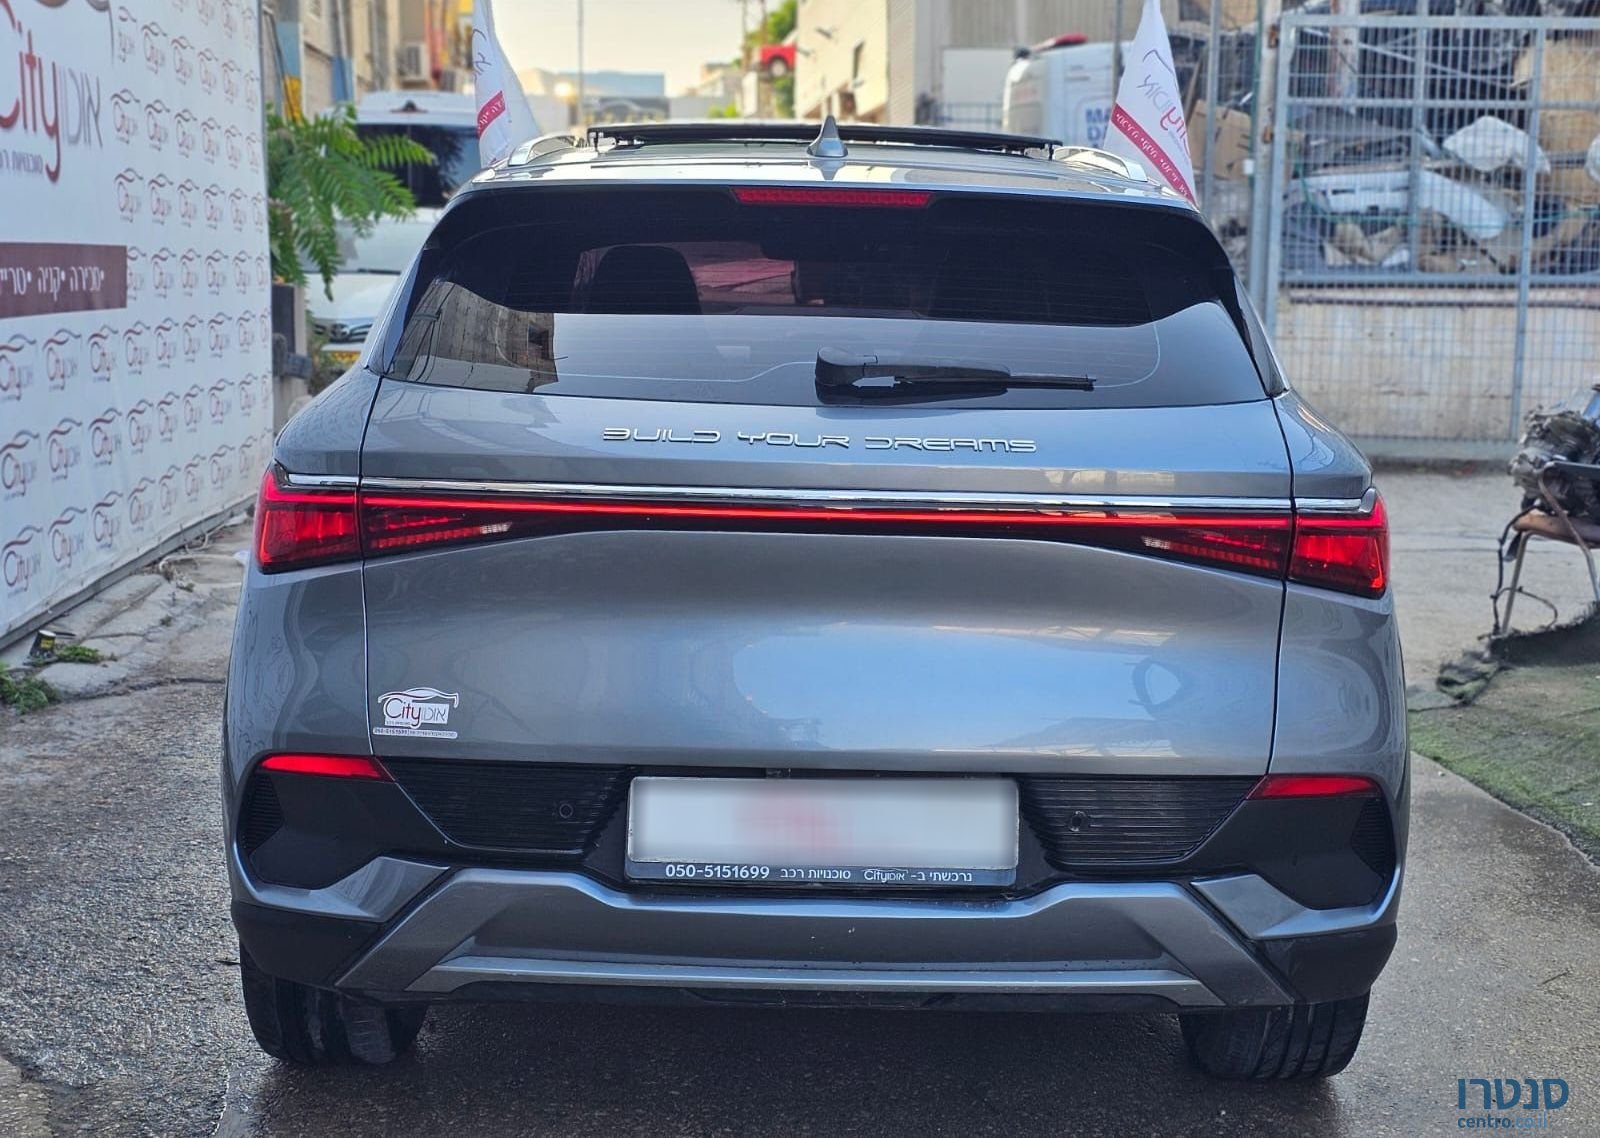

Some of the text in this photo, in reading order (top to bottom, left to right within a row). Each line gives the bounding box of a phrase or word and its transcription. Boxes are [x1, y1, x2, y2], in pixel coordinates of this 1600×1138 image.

[603, 428, 1037, 453] BUILD YOUR DREAMS
[385, 697, 422, 727] City
[665, 864, 770, 879] 050-5151699
[780, 868, 805, 879] רכב
[808, 868, 852, 881] סוכנויות
[929, 872, 973, 882] נרכשתי
